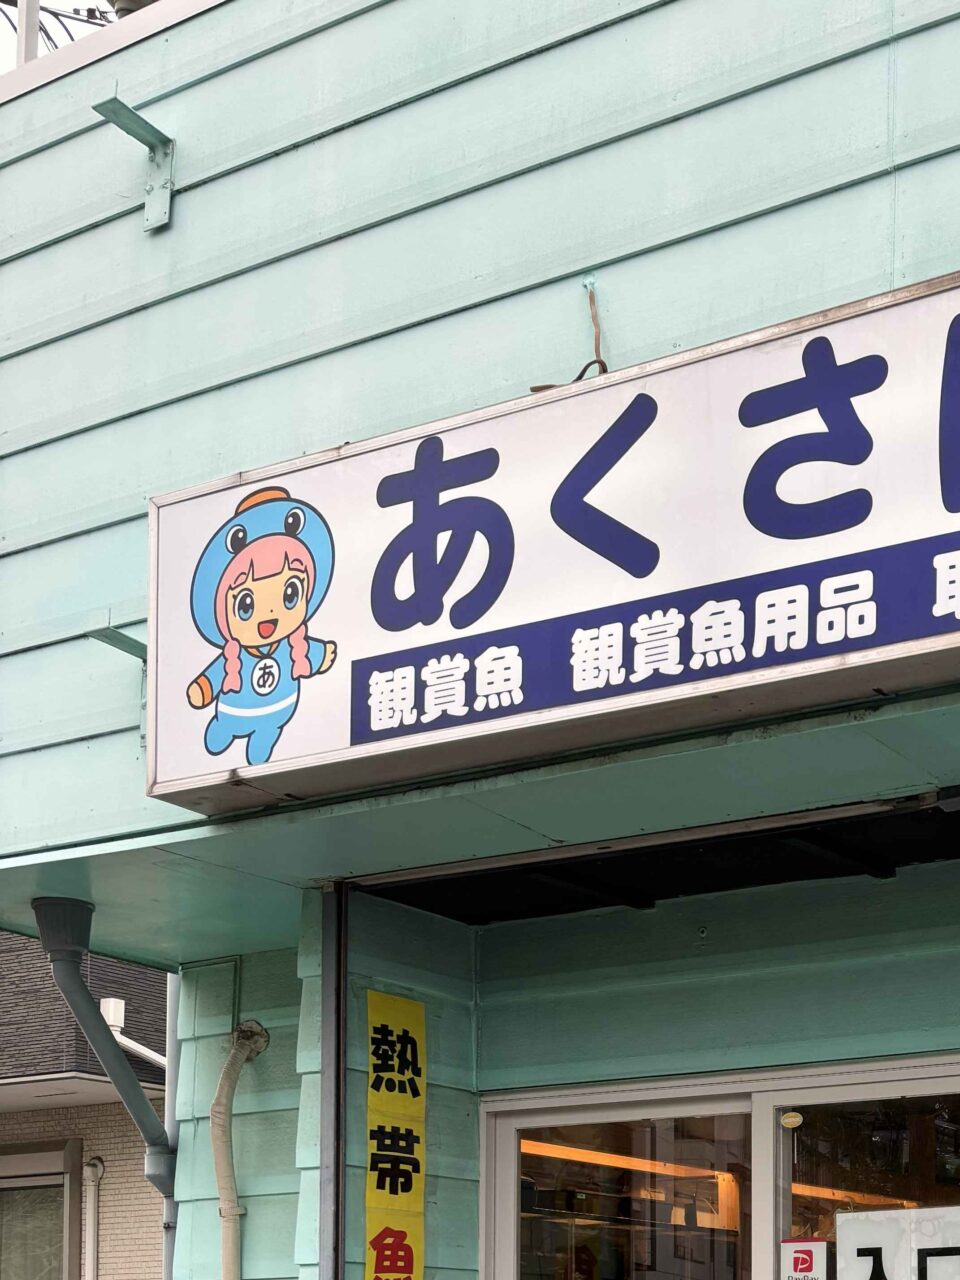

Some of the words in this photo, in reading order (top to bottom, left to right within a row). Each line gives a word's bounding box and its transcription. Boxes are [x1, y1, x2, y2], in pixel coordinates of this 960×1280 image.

[255, 661, 277, 690] あ
[367, 645, 524, 731] 観賞魚
[569, 569, 877, 692] 観賞魚用品
